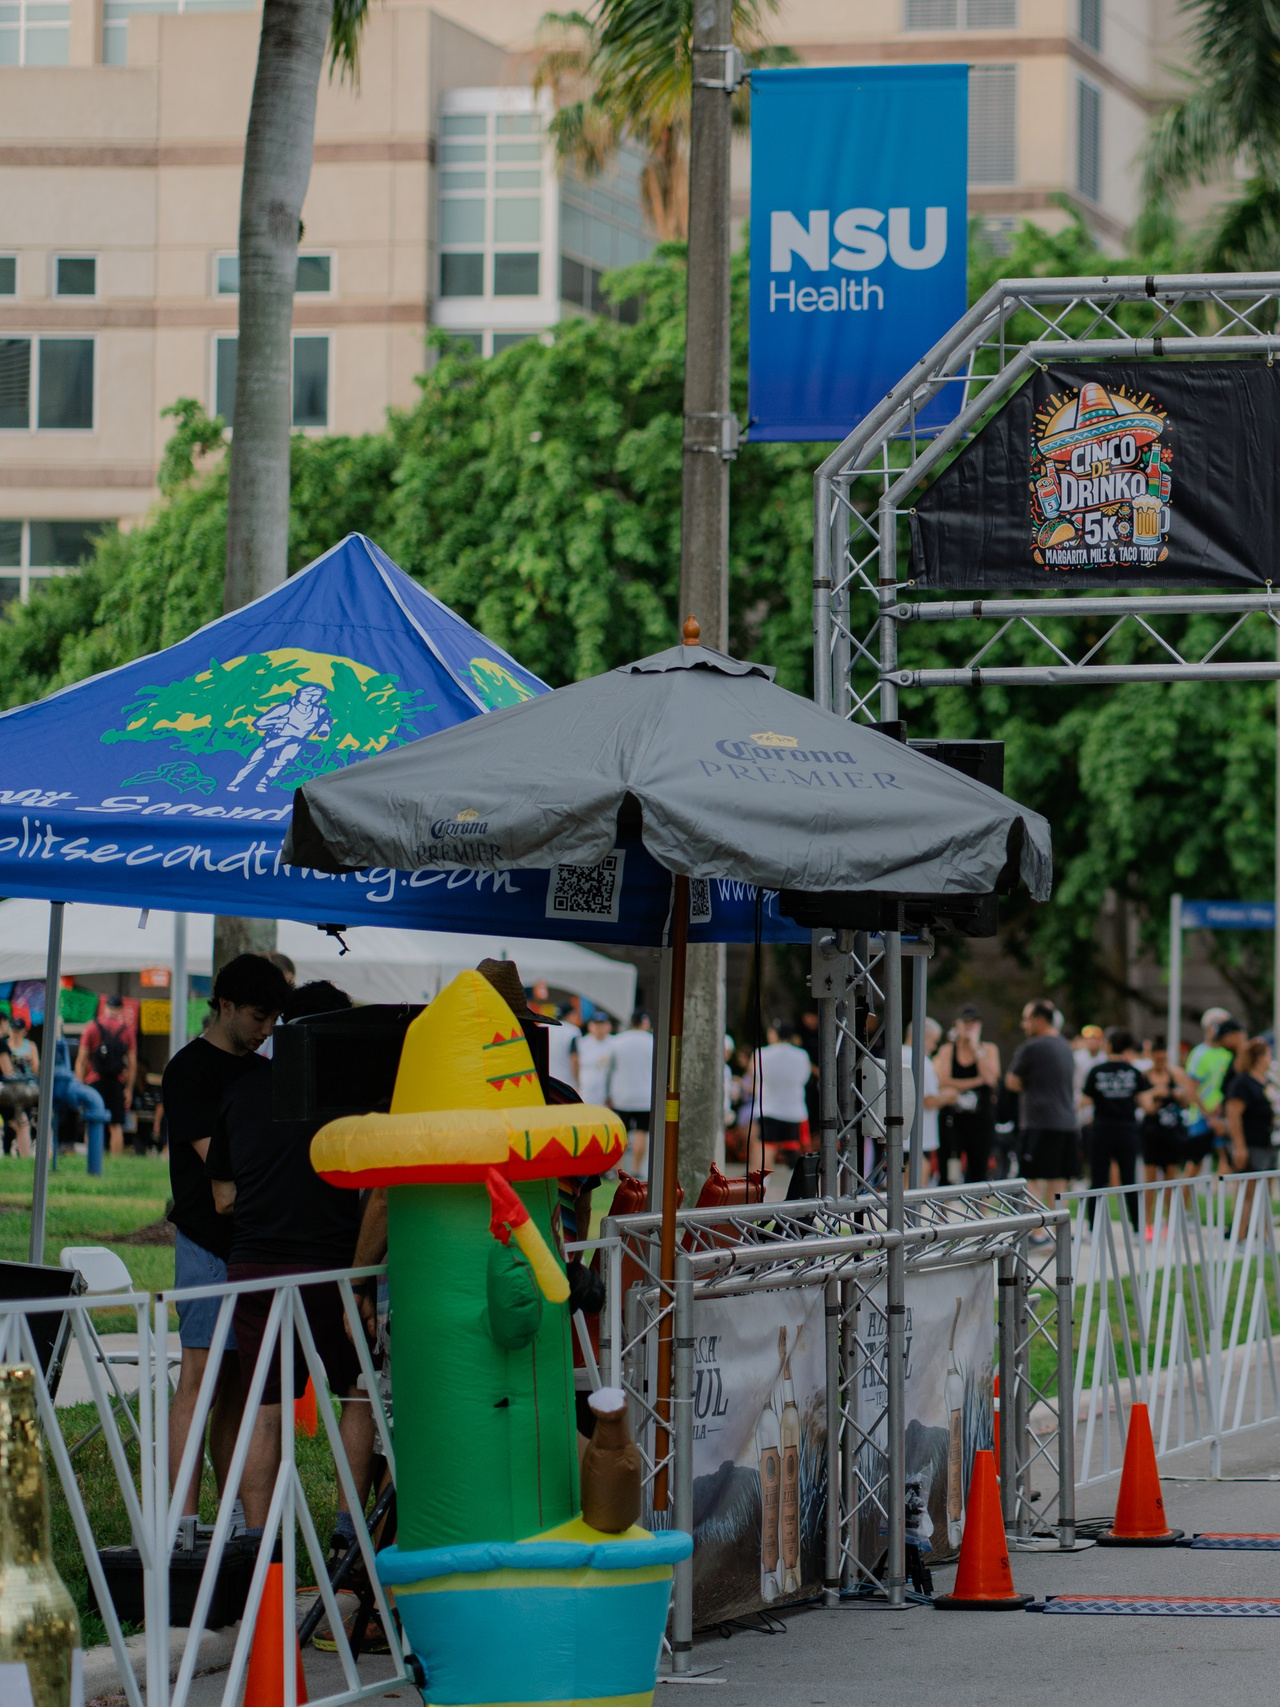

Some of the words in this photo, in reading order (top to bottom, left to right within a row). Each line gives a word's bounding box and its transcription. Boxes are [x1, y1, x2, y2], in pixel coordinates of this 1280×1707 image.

[770, 206, 947, 272] NSU
[770, 276, 884, 312] Health
[1071, 435, 1136, 473] CINCO
[1091, 458, 1111, 478] DE
[1059, 473, 1146, 511] DRINKO
[1085, 512, 1118, 544] 5K
[1045, 549, 1088, 564] MARGARITA
[1090, 548, 1107, 562] MILE
[1109, 549, 1116, 562] &
[1119, 547, 1138, 561] TACO
[1140, 547, 1158, 561] TROT
[715, 738, 858, 764] Corona
[697, 759, 905, 790] PREMIER
[431, 819, 488, 840] Corona
[416, 843, 504, 863] PREMIER
